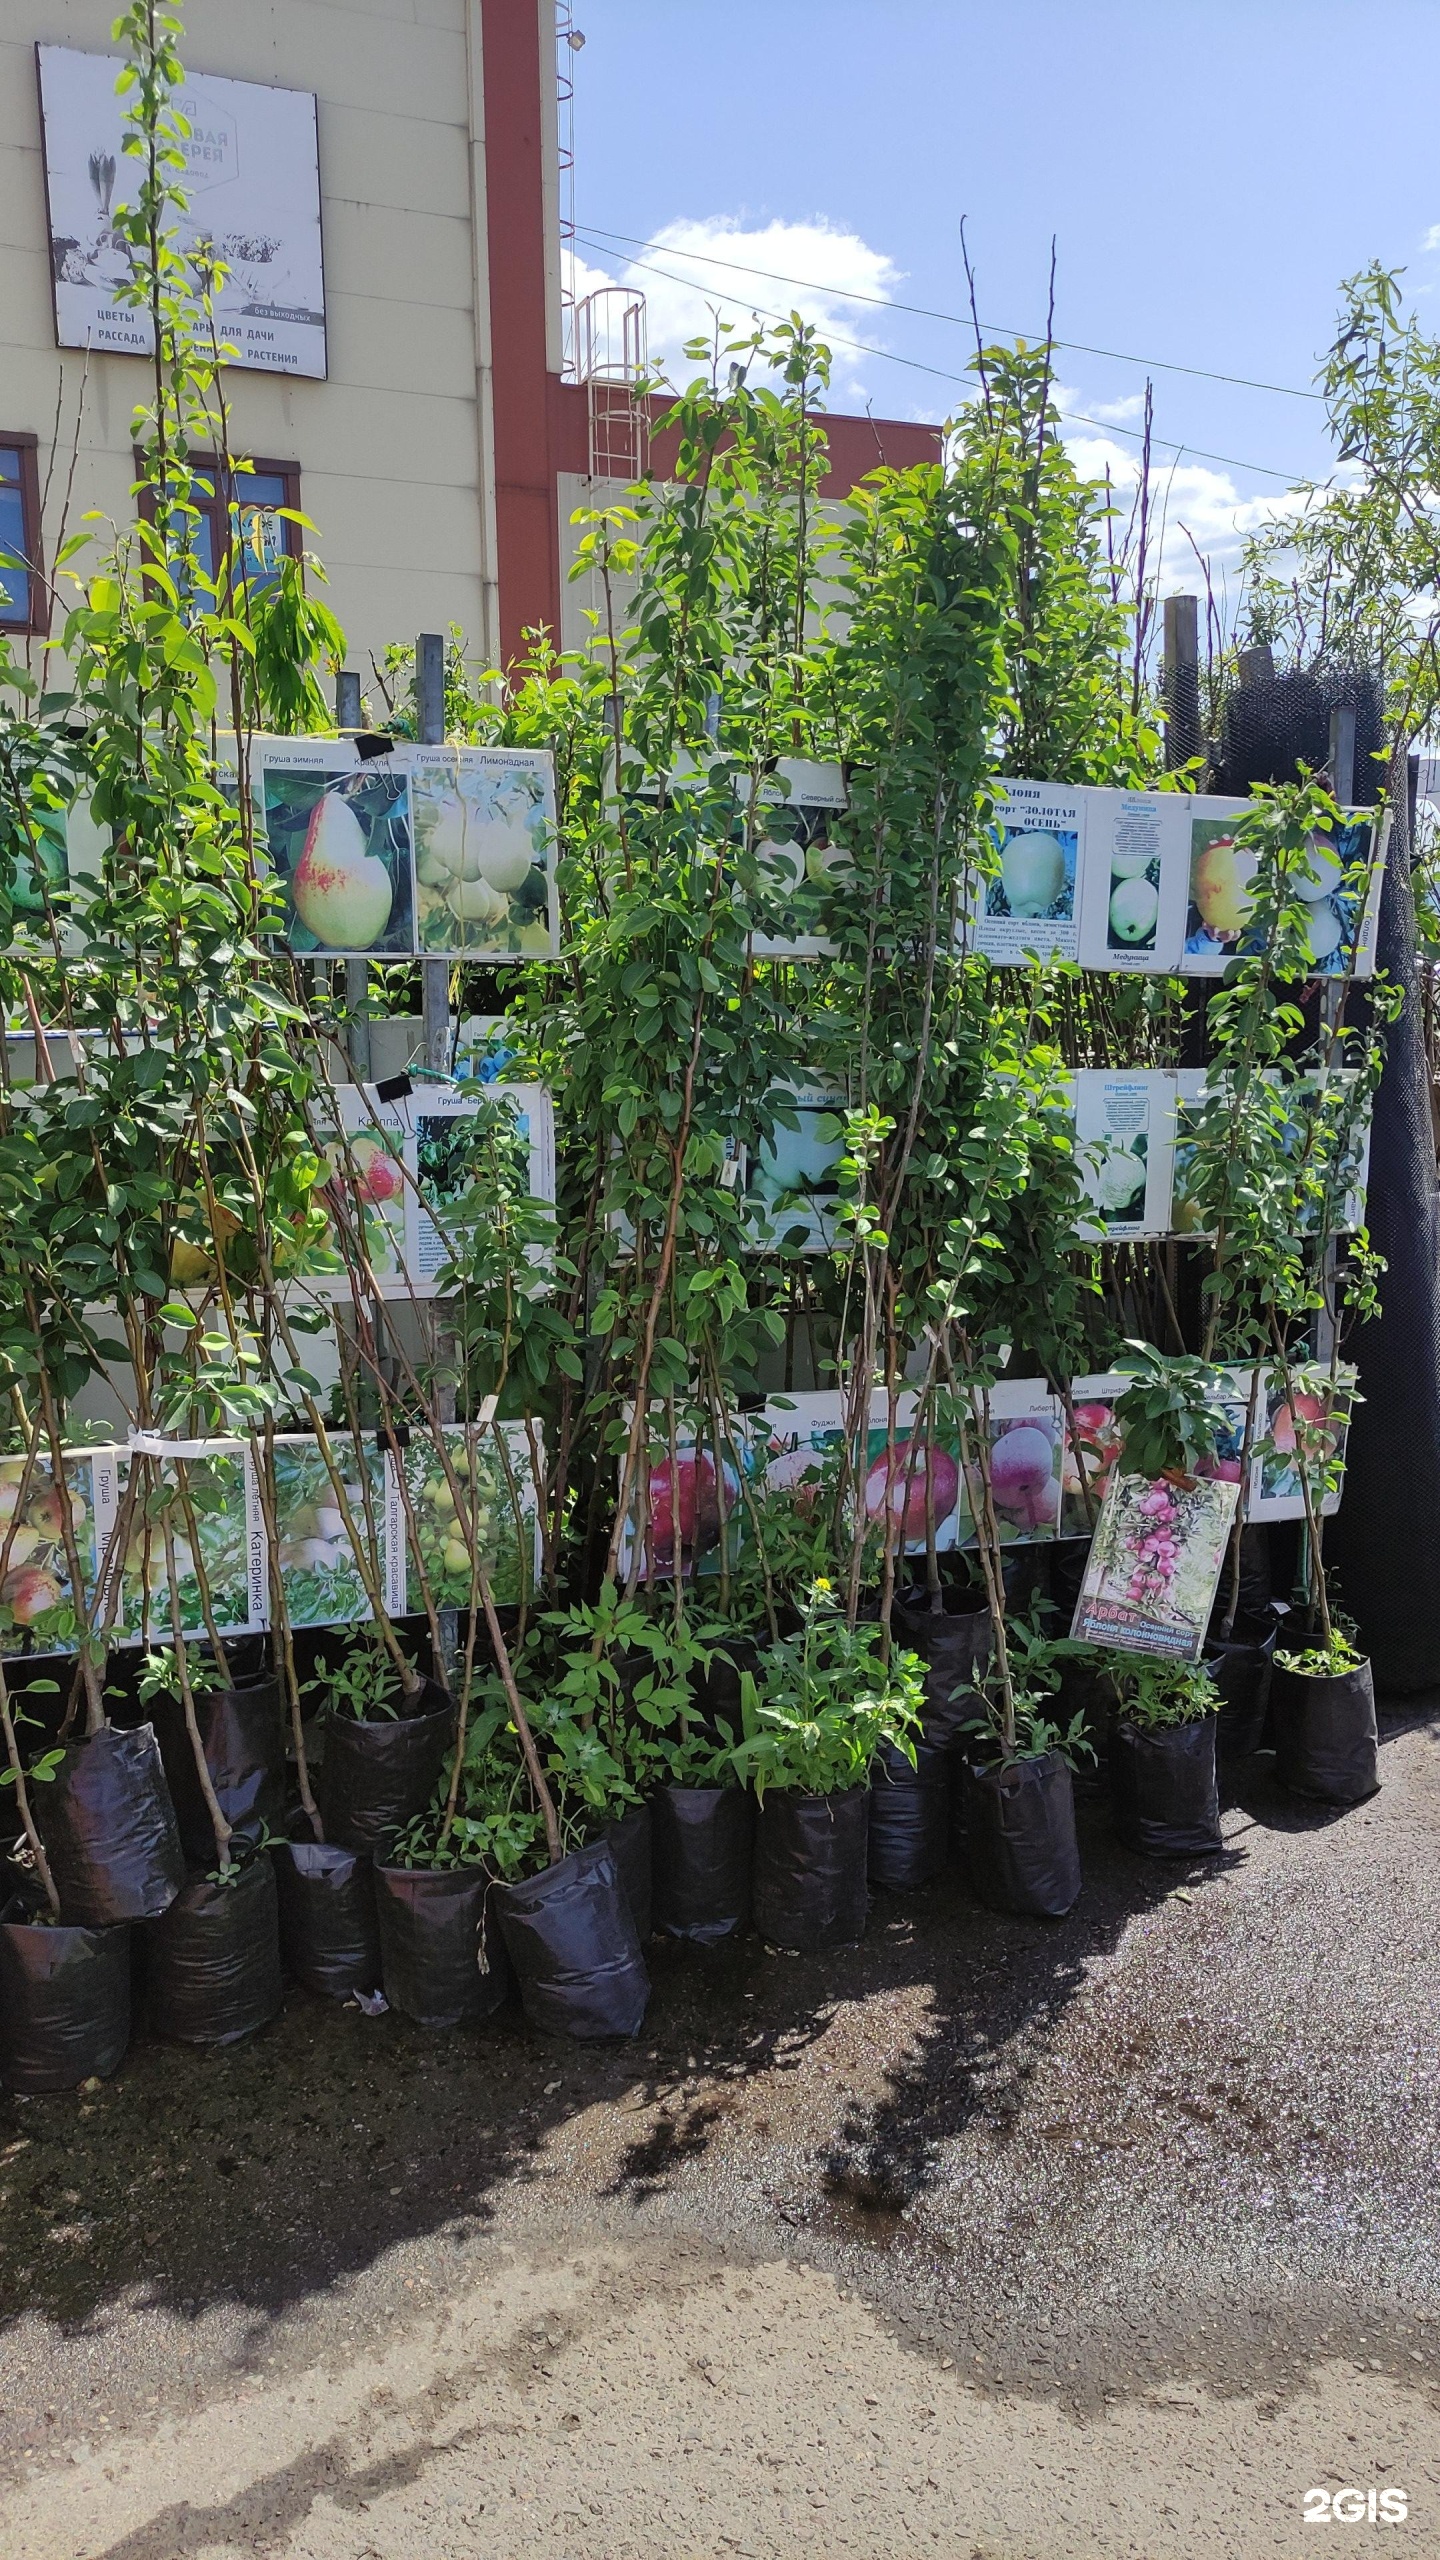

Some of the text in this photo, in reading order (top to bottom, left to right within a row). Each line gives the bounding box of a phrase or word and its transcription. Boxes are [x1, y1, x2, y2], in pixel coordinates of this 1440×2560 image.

[97, 309, 135, 323] ЦВЕТЫ
[220, 325, 242, 338] ДЛЯ
[247, 329, 275, 342] ДАЧИ
[98, 329, 146, 345] РАССАДА
[247, 349, 298, 365] РАСТЕНИЯ
[264, 754, 291, 765] Груша
[292, 756, 324, 765] зимняя
[416, 754, 441, 763] Груша
[479, 755, 535, 768] Лимонадная
[801, 793, 835, 803] Северный
[994, 804, 1017, 815] сорт
[437, 1096, 463, 1107] Груша
[810, 1419, 836, 1428] Фуджи
[99, 1469, 112, 1505] Груша
[388, 1493, 400, 1610] Талгарская красавица
[249, 1530, 264, 1611] Катеринка
[1086, 1601, 1138, 1623] Арбат
[1082, 1617, 1119, 1633] Яблоня
[1120, 1626, 1193, 1648] колонновидная
[1140, 1620, 1195, 1638] Осенний сорт
